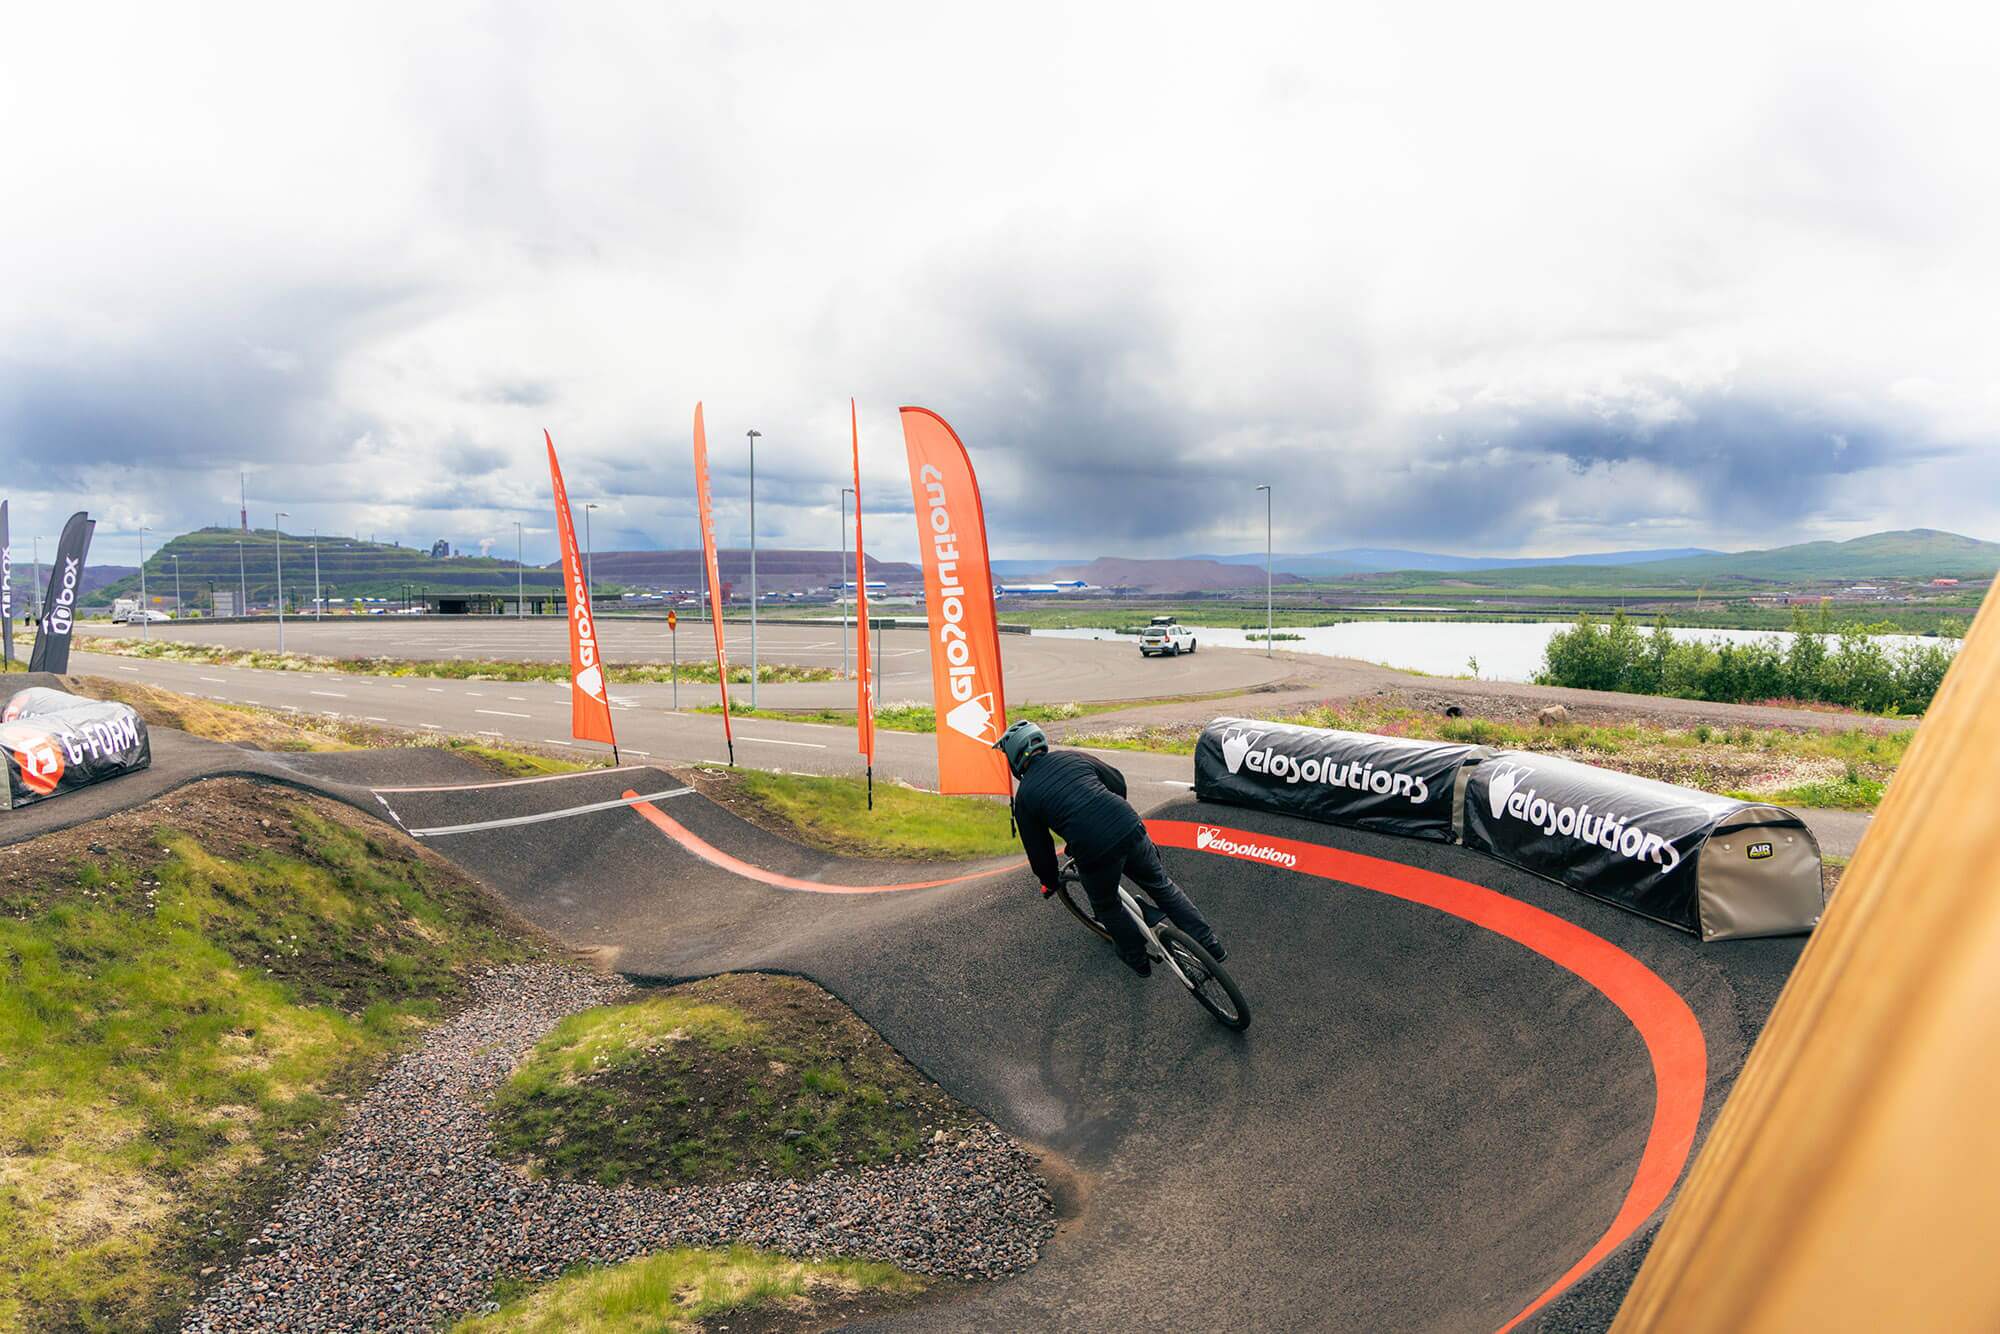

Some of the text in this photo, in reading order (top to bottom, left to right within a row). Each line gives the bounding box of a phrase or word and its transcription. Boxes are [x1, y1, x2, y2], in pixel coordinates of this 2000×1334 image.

[61, 713, 140, 766] G-FORM
[1221, 727, 1429, 804] Velosolutions
[1488, 761, 1680, 874] Velosolutions
[1197, 825, 1297, 867] Velosolutions
[1750, 844, 1771, 856] AIR
